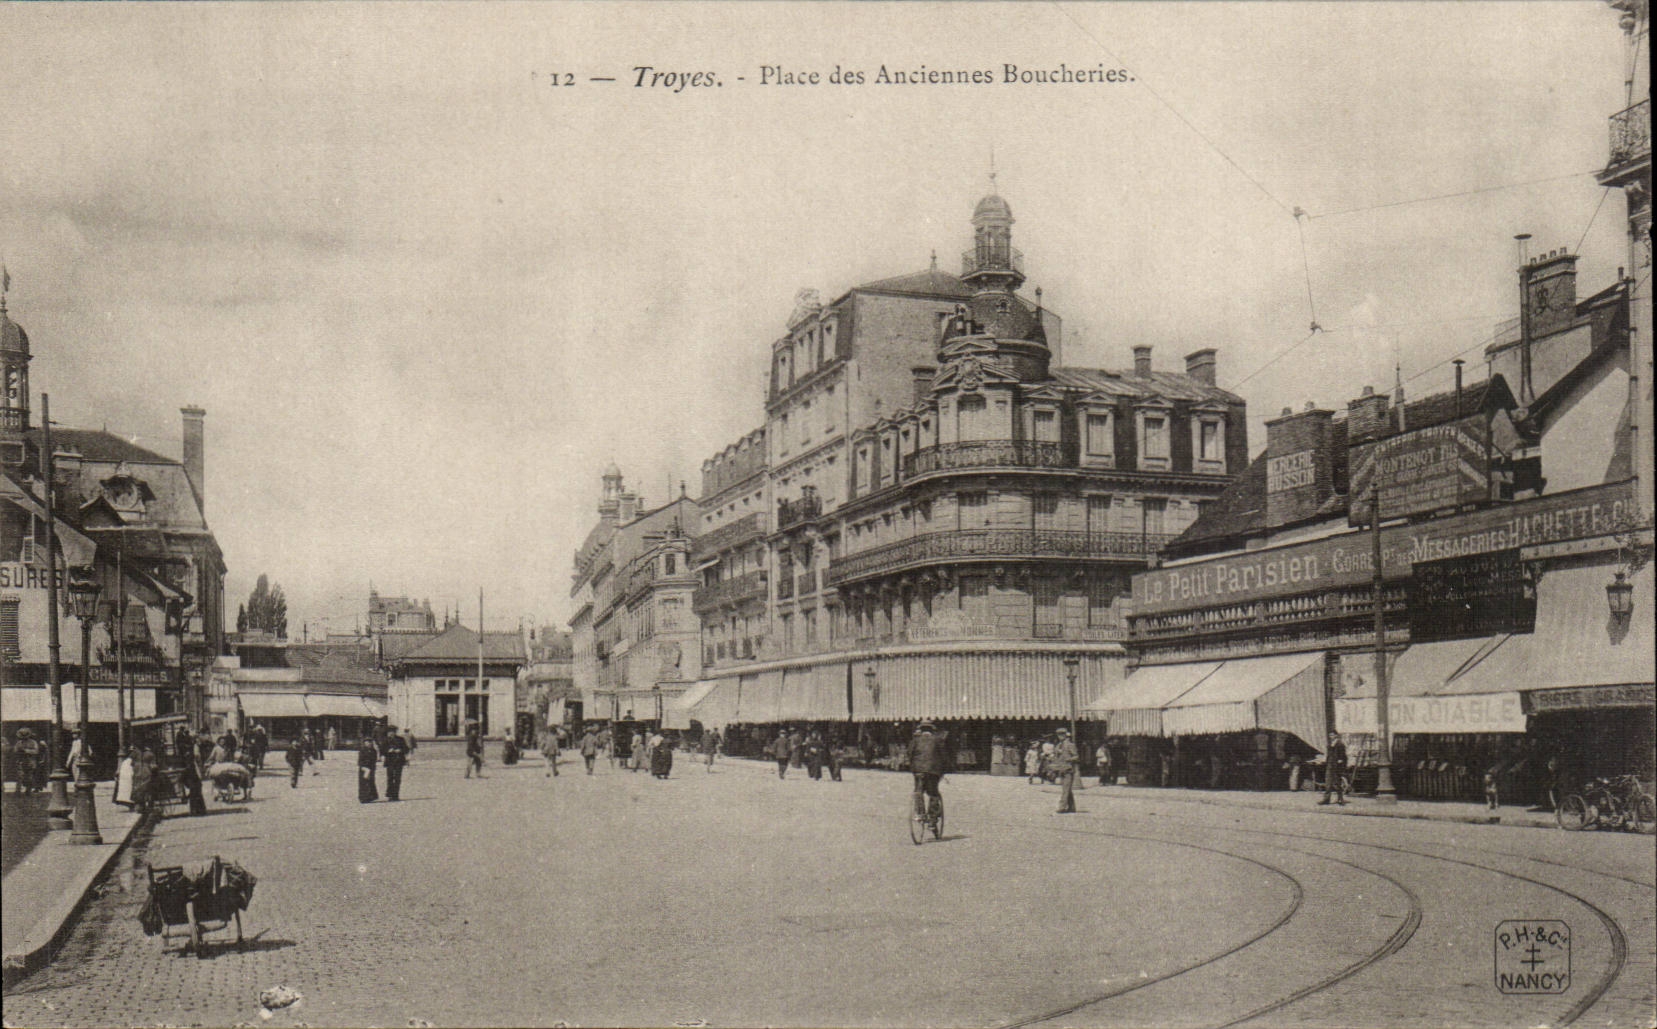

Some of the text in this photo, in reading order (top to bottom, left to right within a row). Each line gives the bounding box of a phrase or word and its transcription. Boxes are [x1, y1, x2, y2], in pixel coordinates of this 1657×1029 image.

[1144, 577, 1162, 604] Le
[1170, 568, 1211, 601] Petit
[1216, 554, 1319, 593] Parisien
[1409, 530, 1505, 563] MESSAGERIES
[1508, 504, 1601, 547] HACHETTE
[1389, 703, 1415, 726] ON
